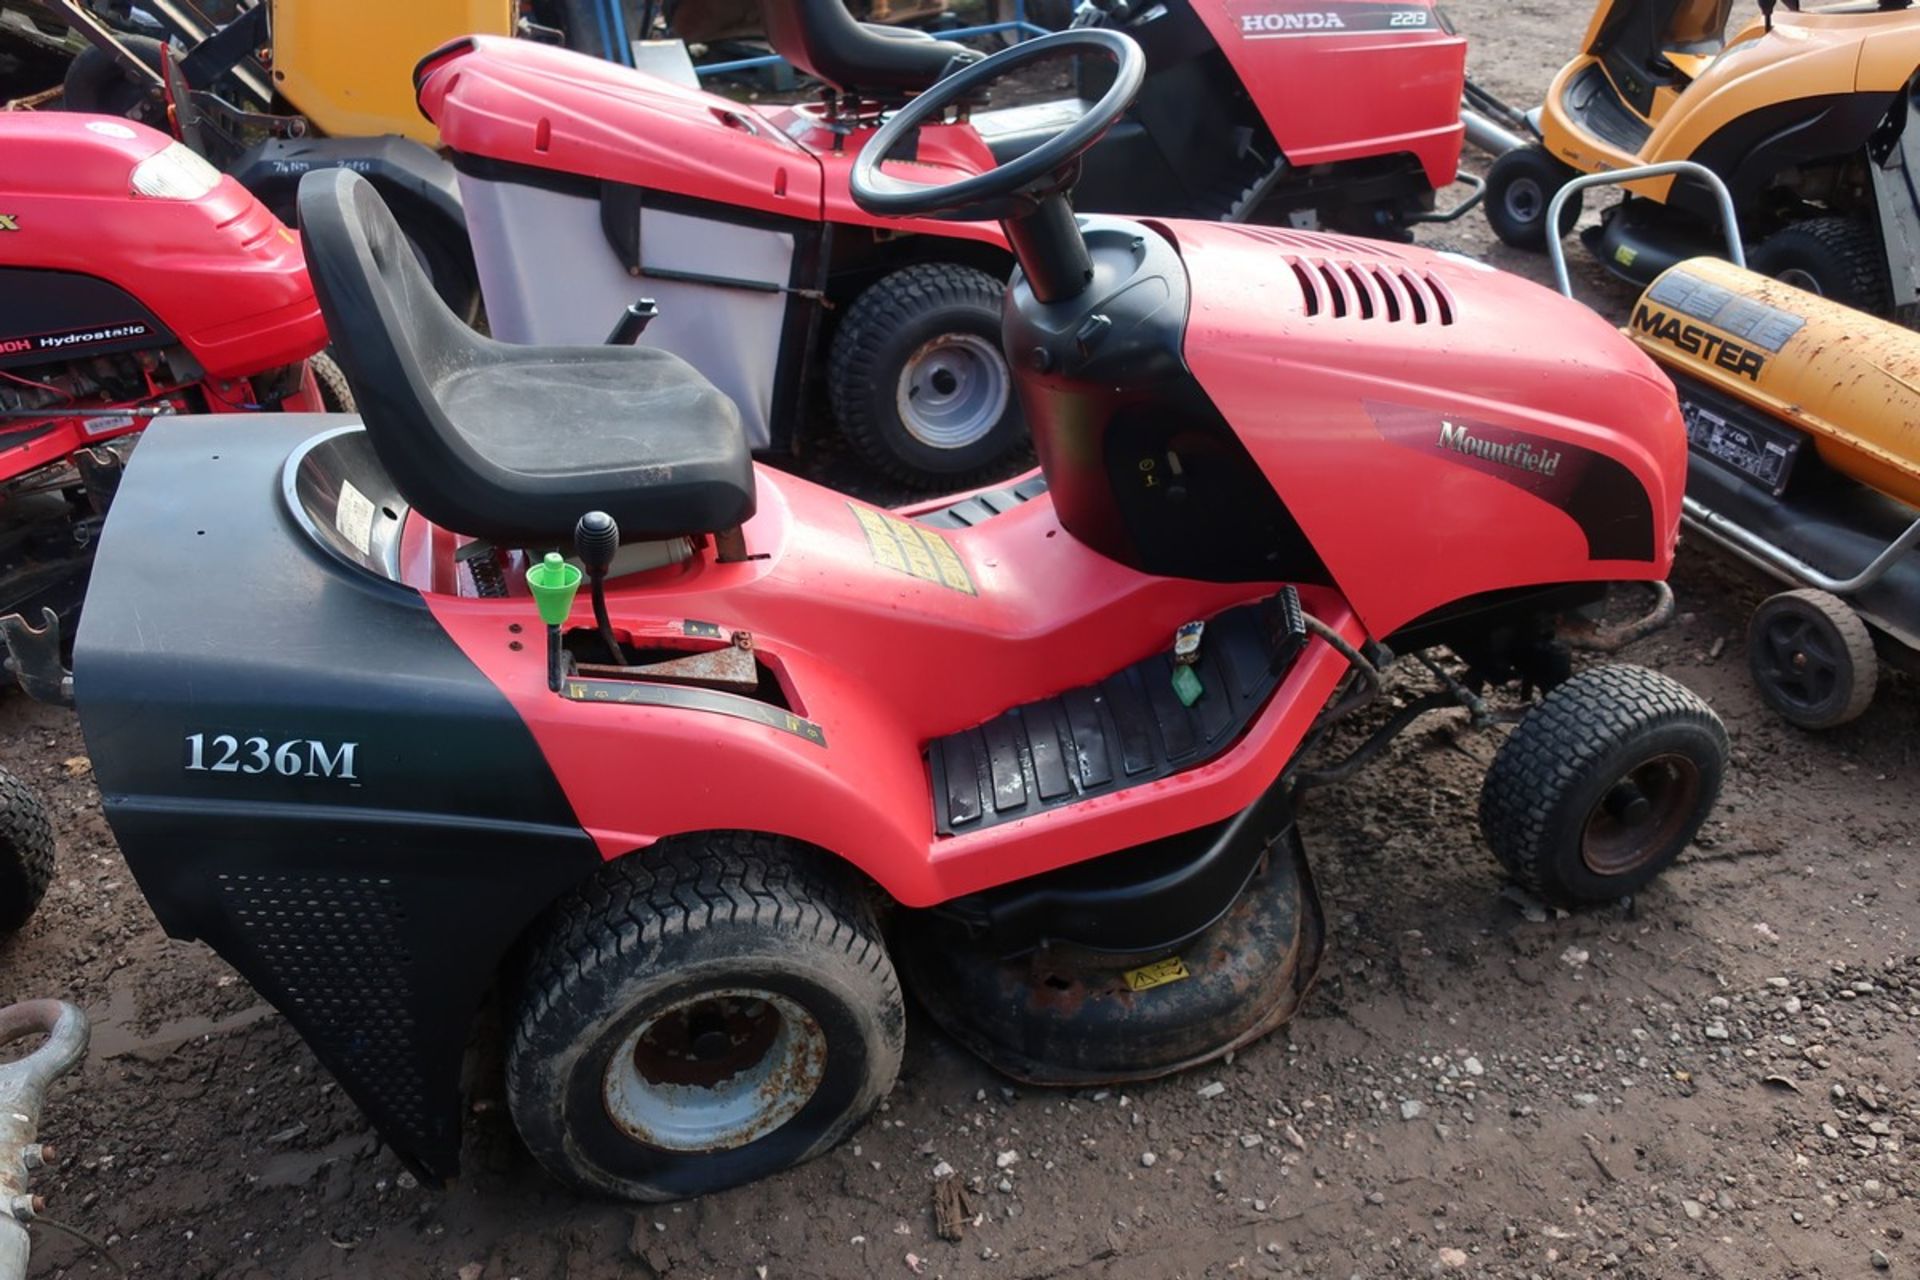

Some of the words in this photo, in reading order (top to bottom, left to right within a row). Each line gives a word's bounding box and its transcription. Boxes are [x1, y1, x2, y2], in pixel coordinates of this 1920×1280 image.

[1241, 12, 1345, 32] HONDA
[1389, 11, 1428, 27] 2213
[40, 325, 145, 348] Hydrostatic
[1632, 303, 1766, 382] MASTER
[1436, 420, 1561, 476] Mountfield
[184, 732, 359, 779] 1236M
